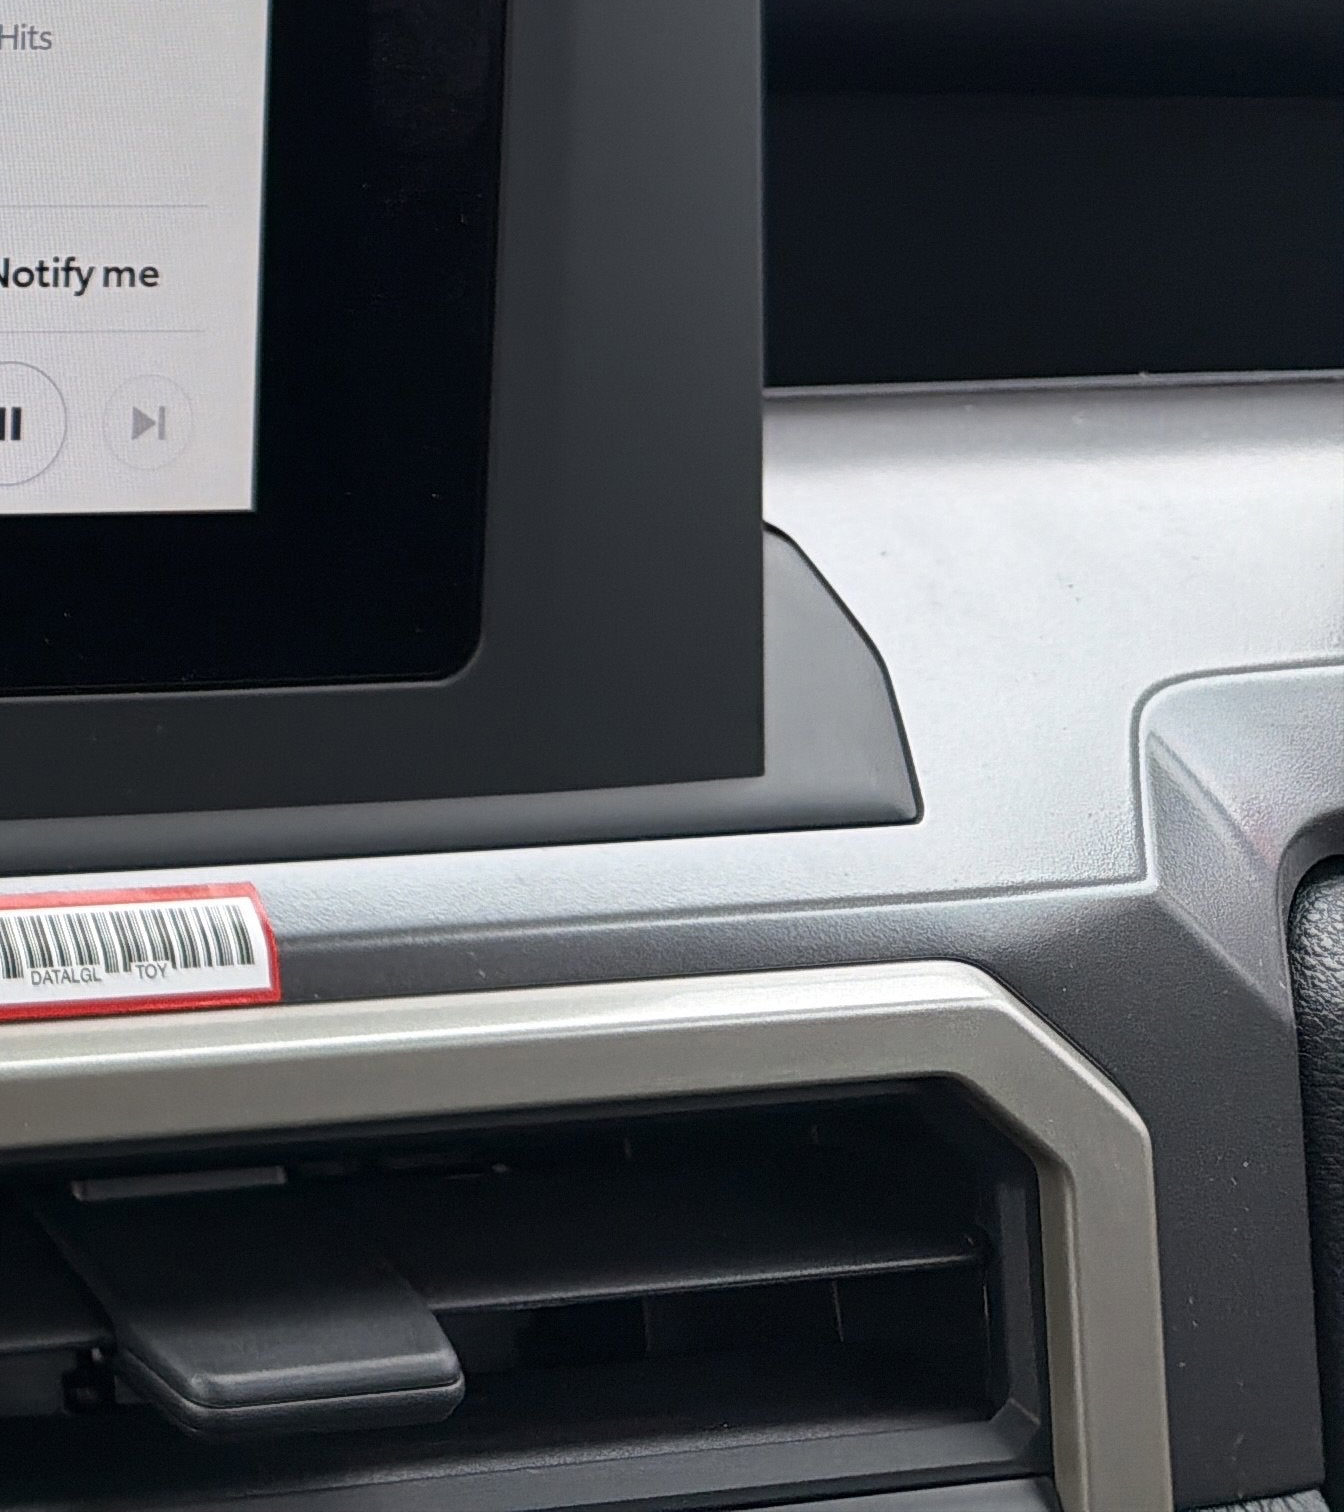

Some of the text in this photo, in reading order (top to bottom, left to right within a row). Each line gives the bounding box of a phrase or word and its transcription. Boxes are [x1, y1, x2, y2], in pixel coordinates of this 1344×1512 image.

[102, 262, 159, 289] me
[31, 965, 101, 986] DATALGL
[135, 963, 169, 979] TOY
